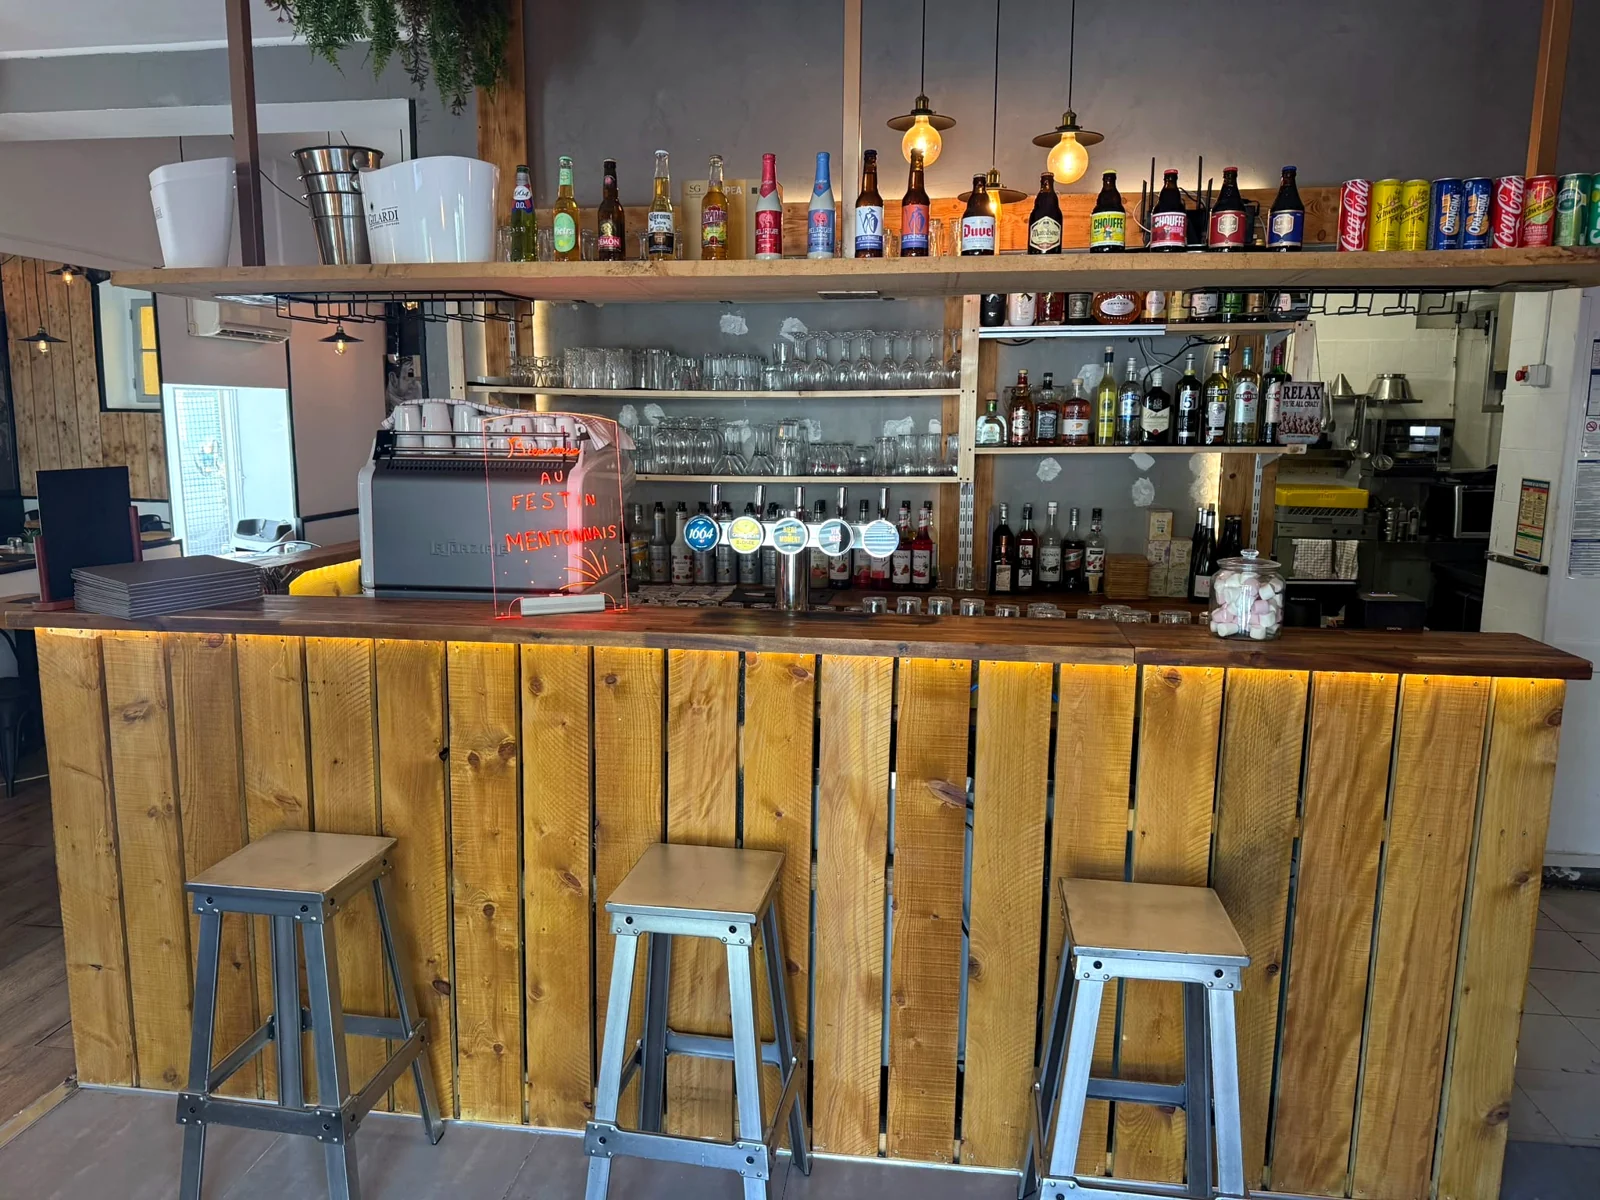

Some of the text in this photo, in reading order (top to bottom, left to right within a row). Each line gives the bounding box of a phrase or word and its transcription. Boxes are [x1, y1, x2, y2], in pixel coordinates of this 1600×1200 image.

[1442, 194, 1461, 233] ORANGINA
[1468, 194, 1489, 233] ORANGINA
[1094, 218, 1123, 230] CHOUFFE
[1154, 216, 1184, 228] CHOUFFE
[963, 224, 994, 238] Duvel
[1283, 386, 1321, 400] RELAX
[541, 470, 563, 485] AU
[511, 491, 597, 511] FESTIN
[505, 524, 617, 553] MENTONNAIS
[689, 526, 714, 539] 1664
